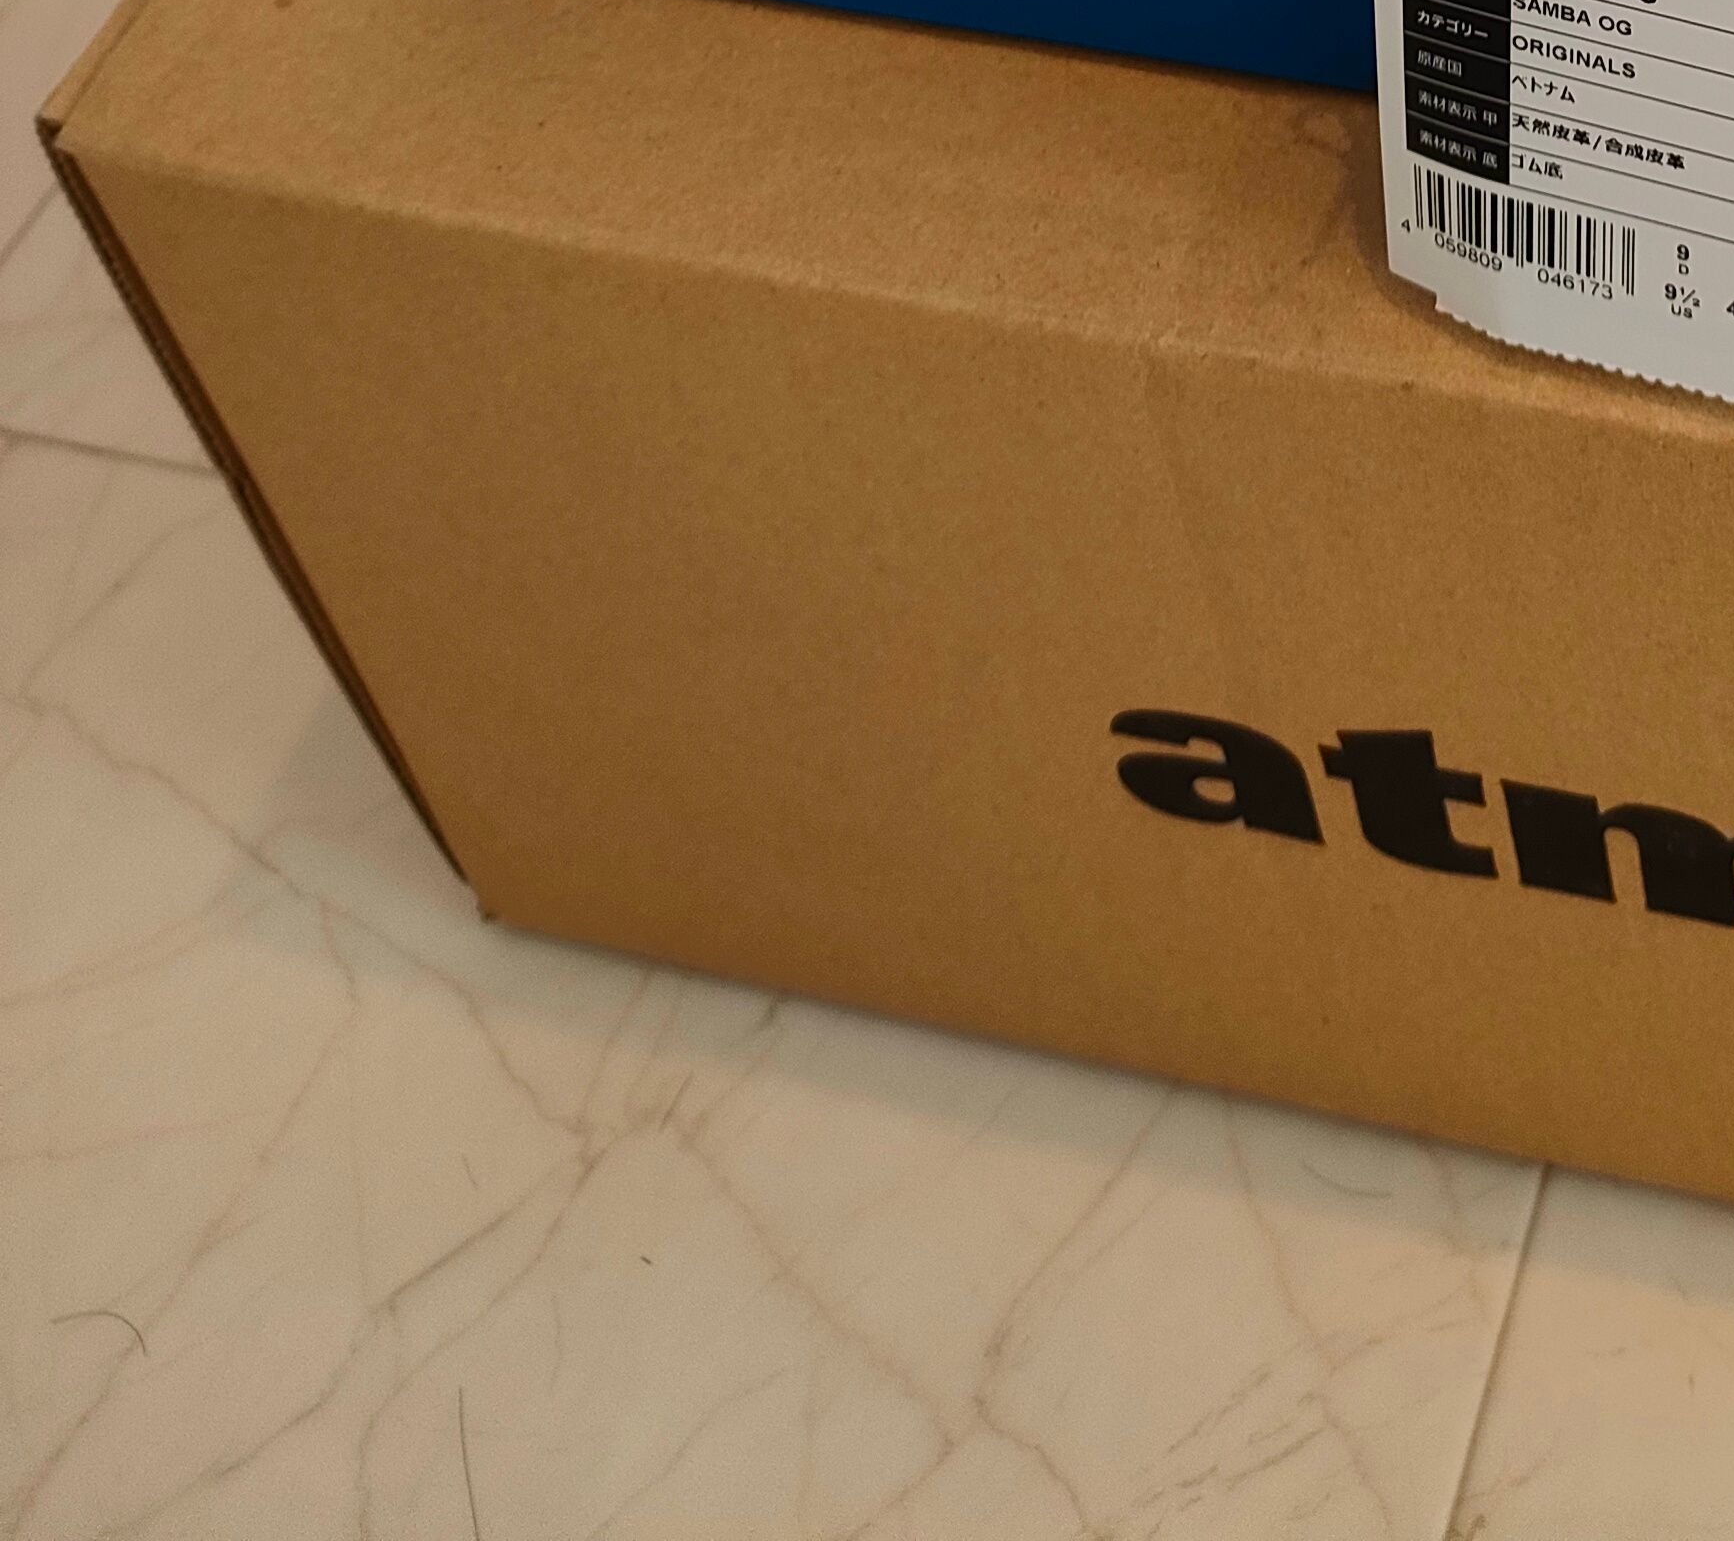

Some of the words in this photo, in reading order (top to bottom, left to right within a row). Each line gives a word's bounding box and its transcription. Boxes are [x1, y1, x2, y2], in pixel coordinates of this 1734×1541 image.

[1417, 9, 1489, 39] カテゴリー
[1599, 15, 1633, 36] OG
[1512, 35, 1636, 79] ORIGINALS
[1511, 74, 1576, 104] ベトナム
[1511, 153, 1564, 180] ゴム底
[1401, 218, 1411, 233] 4
[1434, 232, 1503, 272] 059809
[1537, 268, 1613, 300] 046173
[1676, 244, 1690, 261] 9
[1678, 263, 1690, 276] D
[1671, 303, 1693, 319] US
